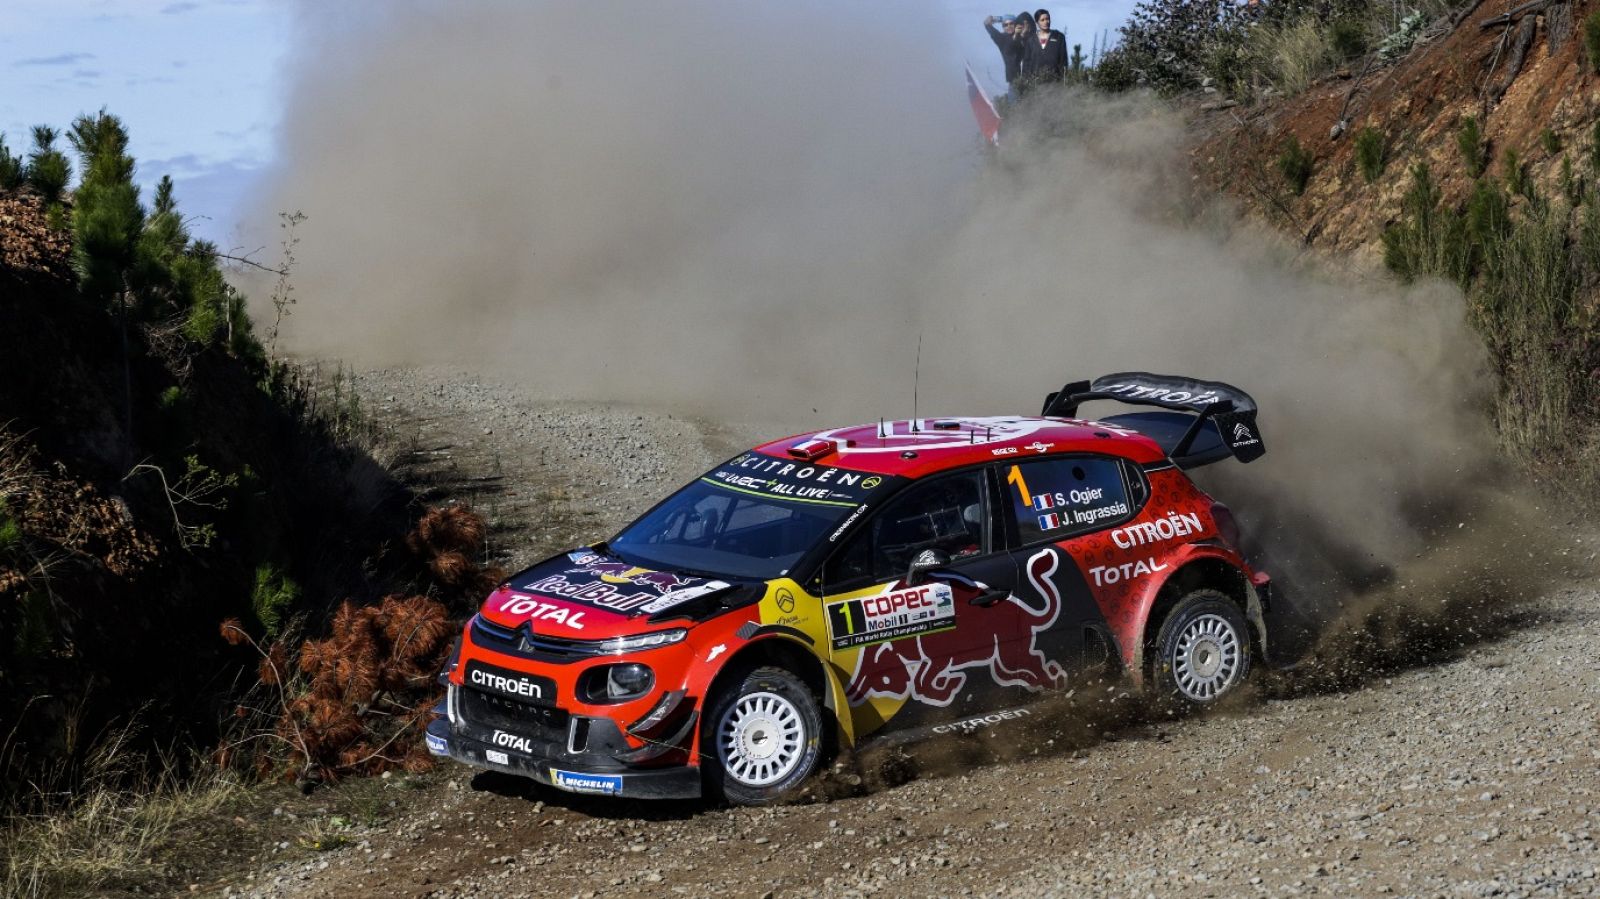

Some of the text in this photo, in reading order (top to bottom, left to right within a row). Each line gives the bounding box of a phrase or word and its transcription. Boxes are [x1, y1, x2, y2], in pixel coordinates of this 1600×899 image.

[741, 456, 861, 486] CITROËN
[770, 483, 796, 495] ALL
[796, 486, 829, 499] LIVE
[1007, 465, 1033, 507] 1
[1055, 487, 1103, 506] S. Ogier
[1062, 501, 1129, 526] J. Ingrassia
[1111, 511, 1204, 549] CITROËN
[1089, 557, 1168, 587] TOTAL
[500, 594, 585, 630] TOTAL
[864, 588, 933, 618] COPEC
[838, 602, 855, 635] 1
[868, 616, 897, 632] Mobil
[471, 669, 542, 699] CITROËN
[480, 693, 552, 717] RACING
[932, 706, 1031, 734] CITROËN
[492, 729, 534, 753] TOTAL
[565, 778, 615, 789] MICHELIN
